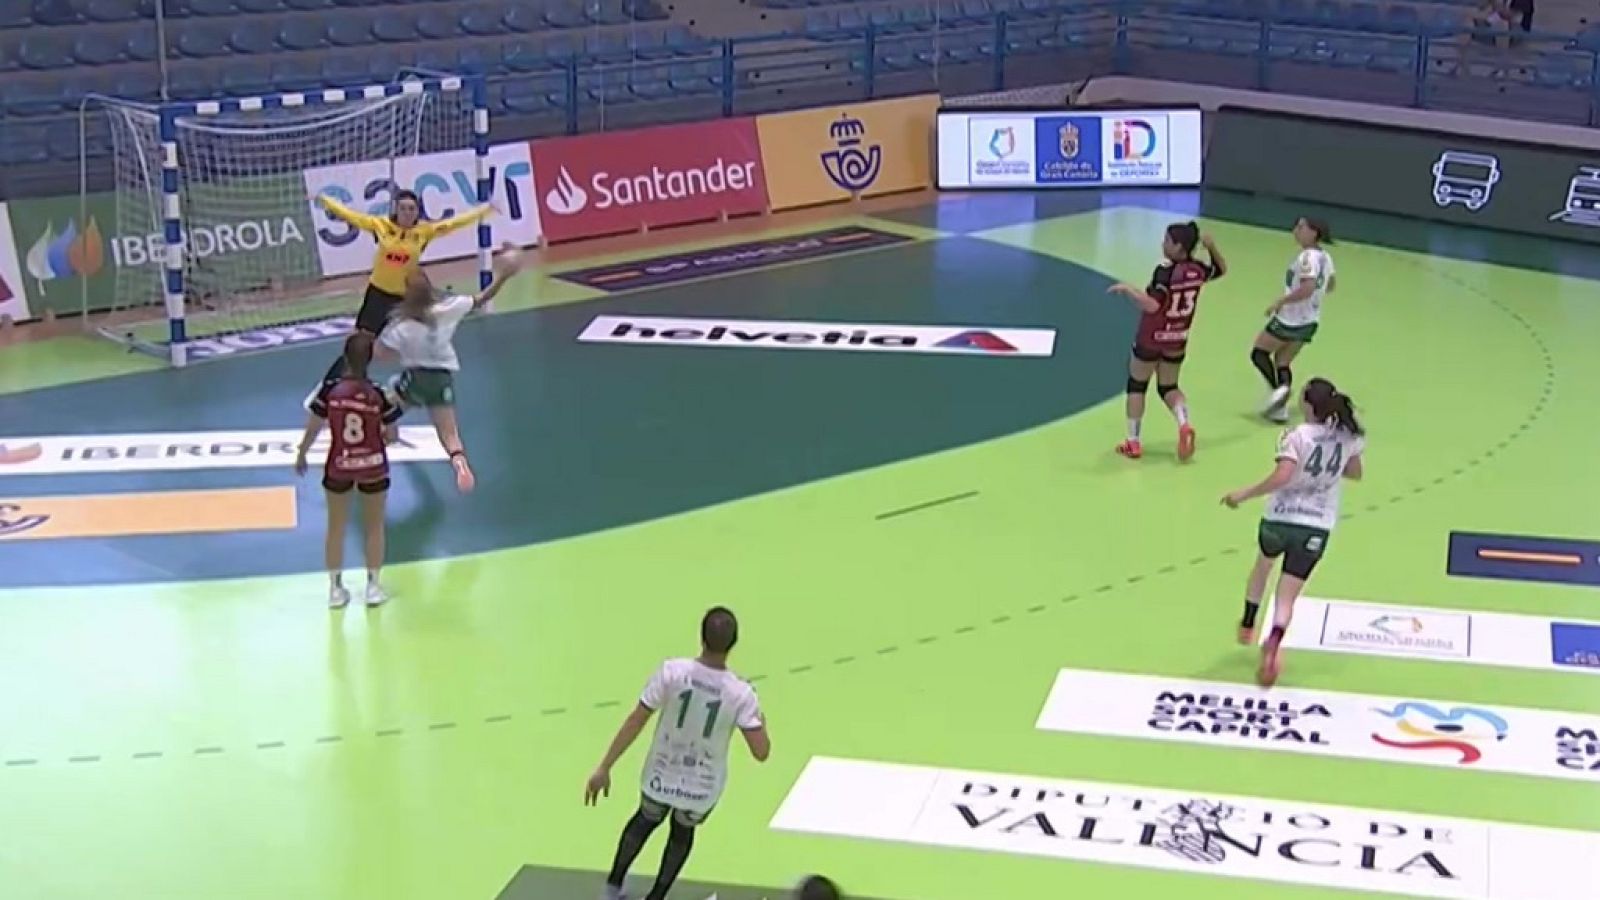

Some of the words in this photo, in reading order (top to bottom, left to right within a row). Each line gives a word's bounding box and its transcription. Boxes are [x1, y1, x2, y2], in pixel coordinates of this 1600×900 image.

[591, 157, 756, 209] Santander
[1166, 289, 1197, 318] 13
[610, 322, 917, 347] helvetia
[343, 412, 365, 444] 8
[1303, 442, 1343, 478] 44
[675, 688, 722, 739] 11
[1152, 703, 1298, 727] SPORT
[1155, 690, 1331, 718] MELILLA
[1146, 719, 1331, 745] CAPITAL
[1369, 820, 1453, 844] DE
